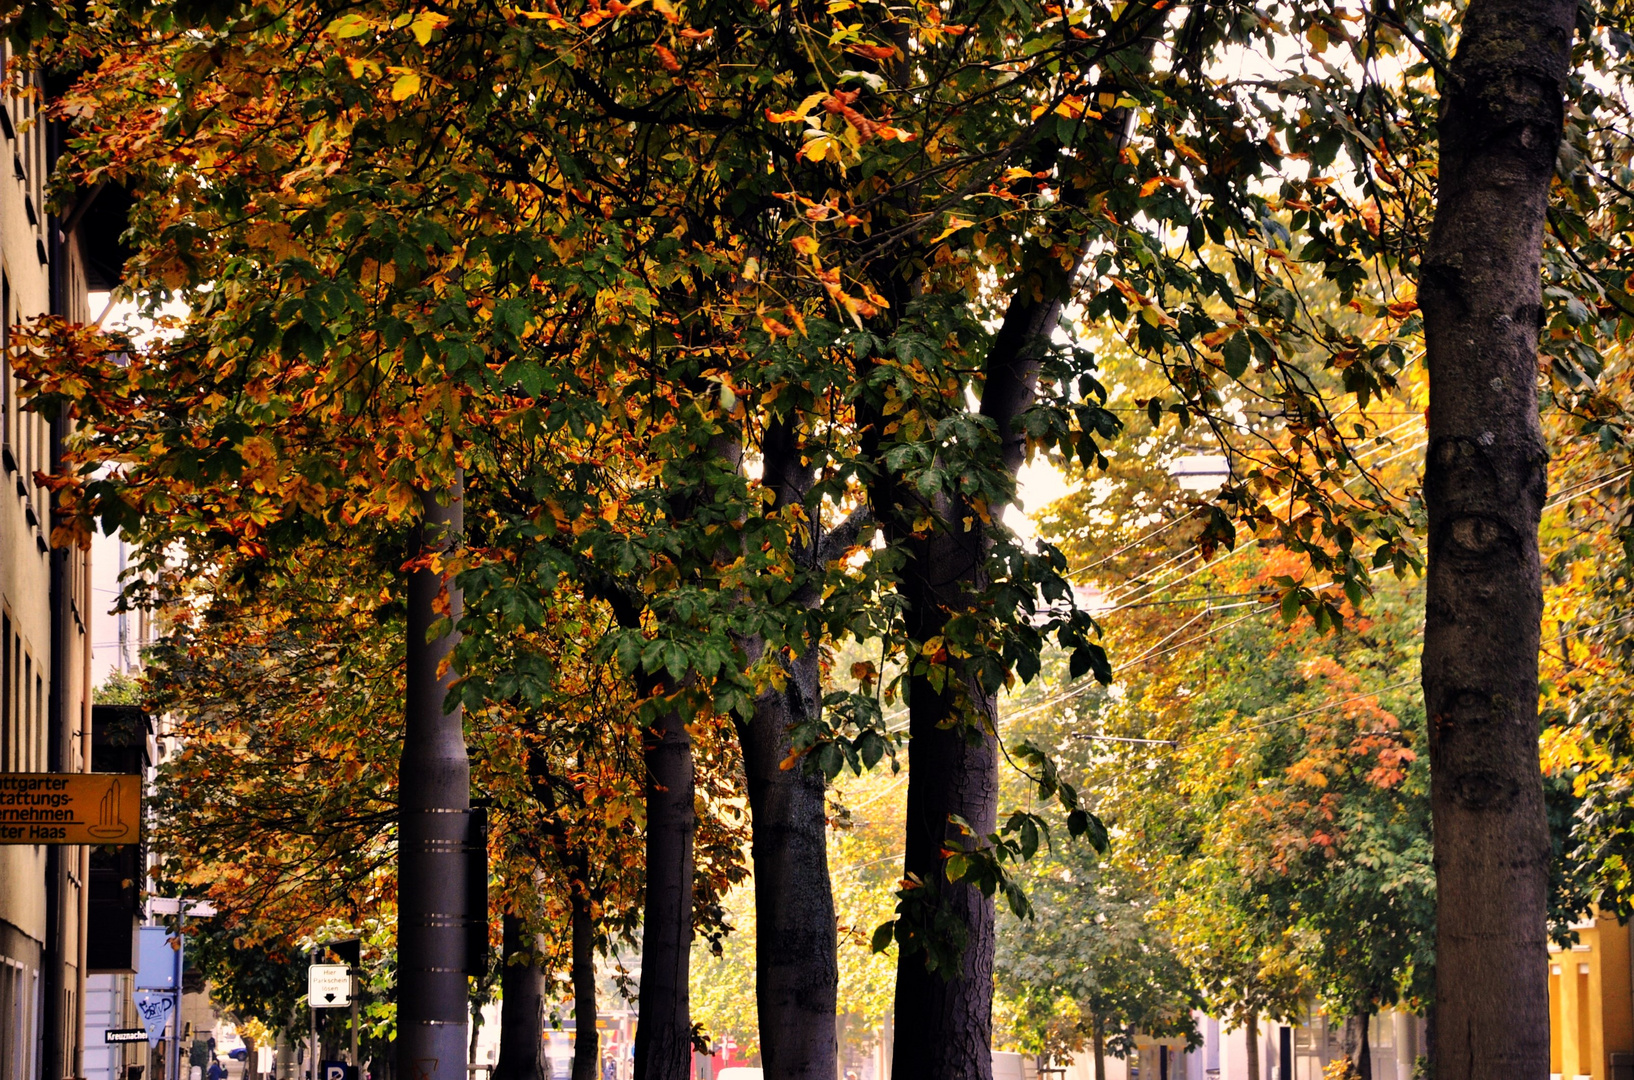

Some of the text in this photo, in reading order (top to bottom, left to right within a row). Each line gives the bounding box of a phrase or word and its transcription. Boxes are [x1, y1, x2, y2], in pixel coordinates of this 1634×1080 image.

[0, 792, 73, 807] tattungs-
[0, 807, 74, 820] rnehmen
[29, 825, 66, 838] Haas
